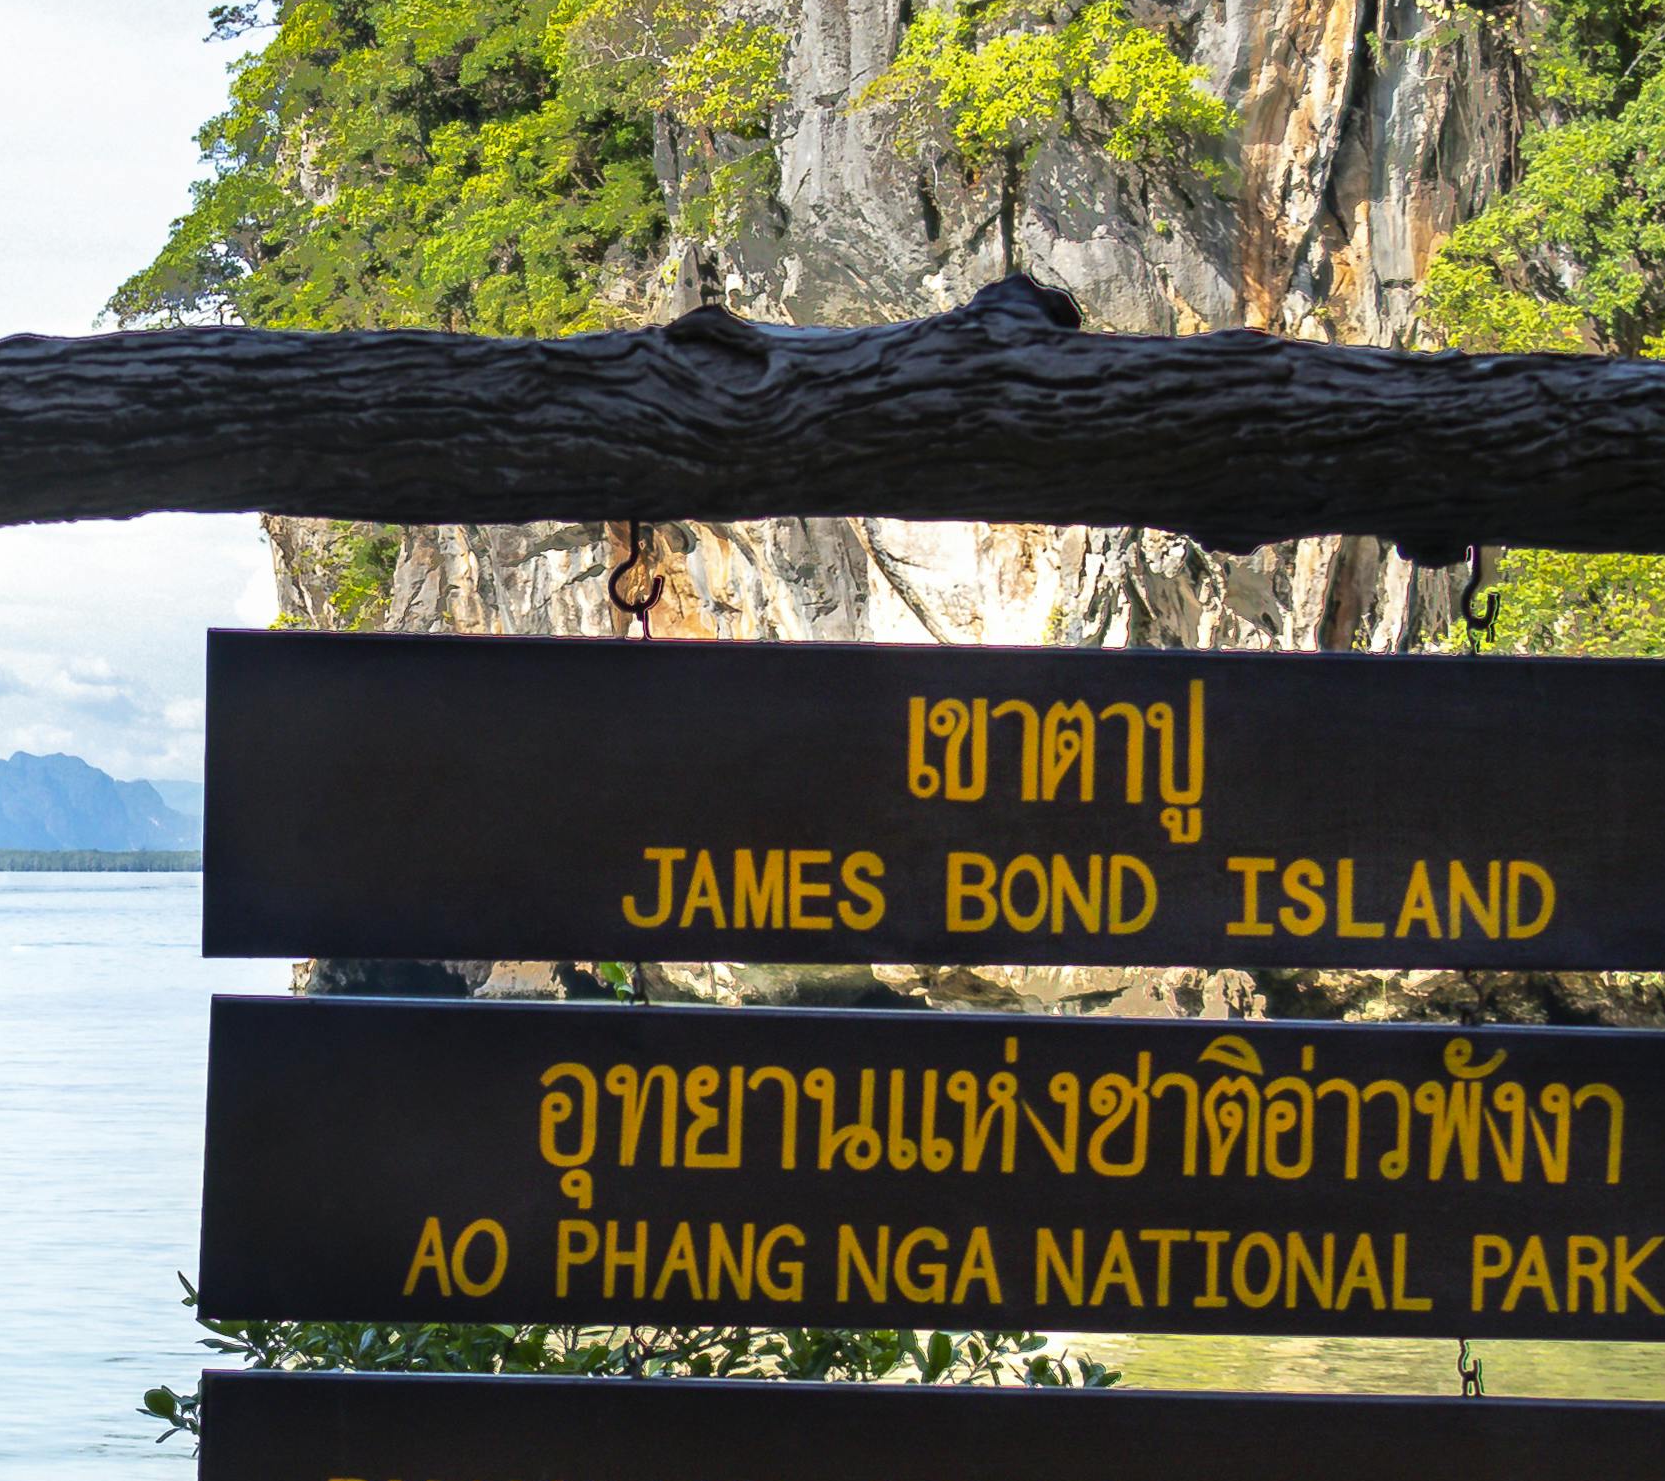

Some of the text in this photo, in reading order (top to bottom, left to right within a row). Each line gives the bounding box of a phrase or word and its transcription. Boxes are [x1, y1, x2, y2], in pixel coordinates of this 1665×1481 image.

[908, 679, 1204, 844] เขาตาปู
[622, 847, 1555, 940] JAMES BOND ISLAND
[539, 1035, 1623, 1209] อุทยานแห่งชาติอ่าวพังงา
[403, 1216, 508, 1297] AO
[556, 1220, 805, 1302] PHANG
[837, 1223, 1002, 1304] NGA
[1036, 1227, 1432, 1310] NATIONAL
